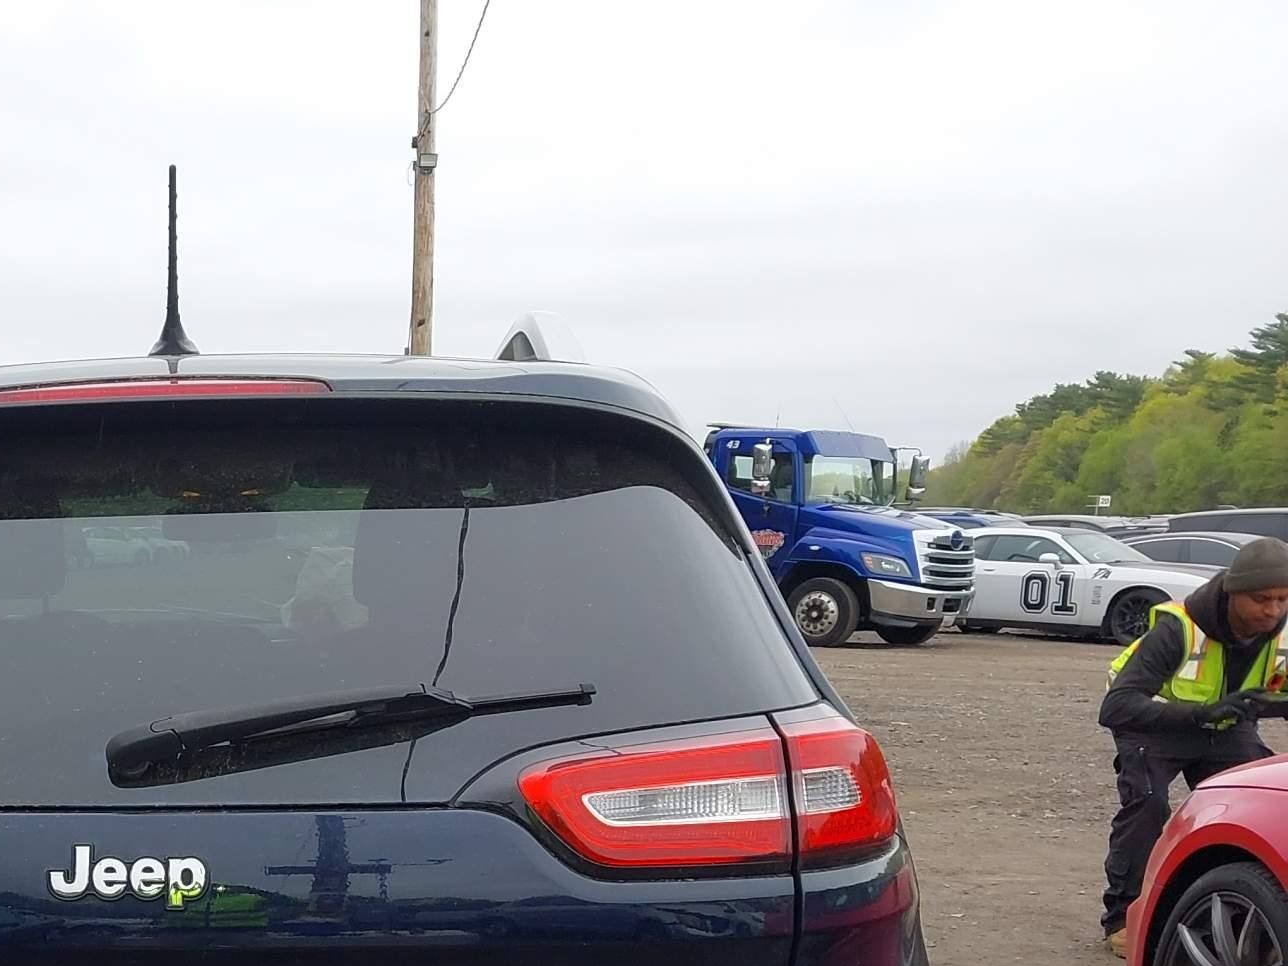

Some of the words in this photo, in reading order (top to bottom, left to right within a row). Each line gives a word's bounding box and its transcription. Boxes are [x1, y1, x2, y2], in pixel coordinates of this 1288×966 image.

[726, 440, 740, 449] 43
[1020, 569, 1078, 616] 01
[48, 844, 207, 908] Jeep
